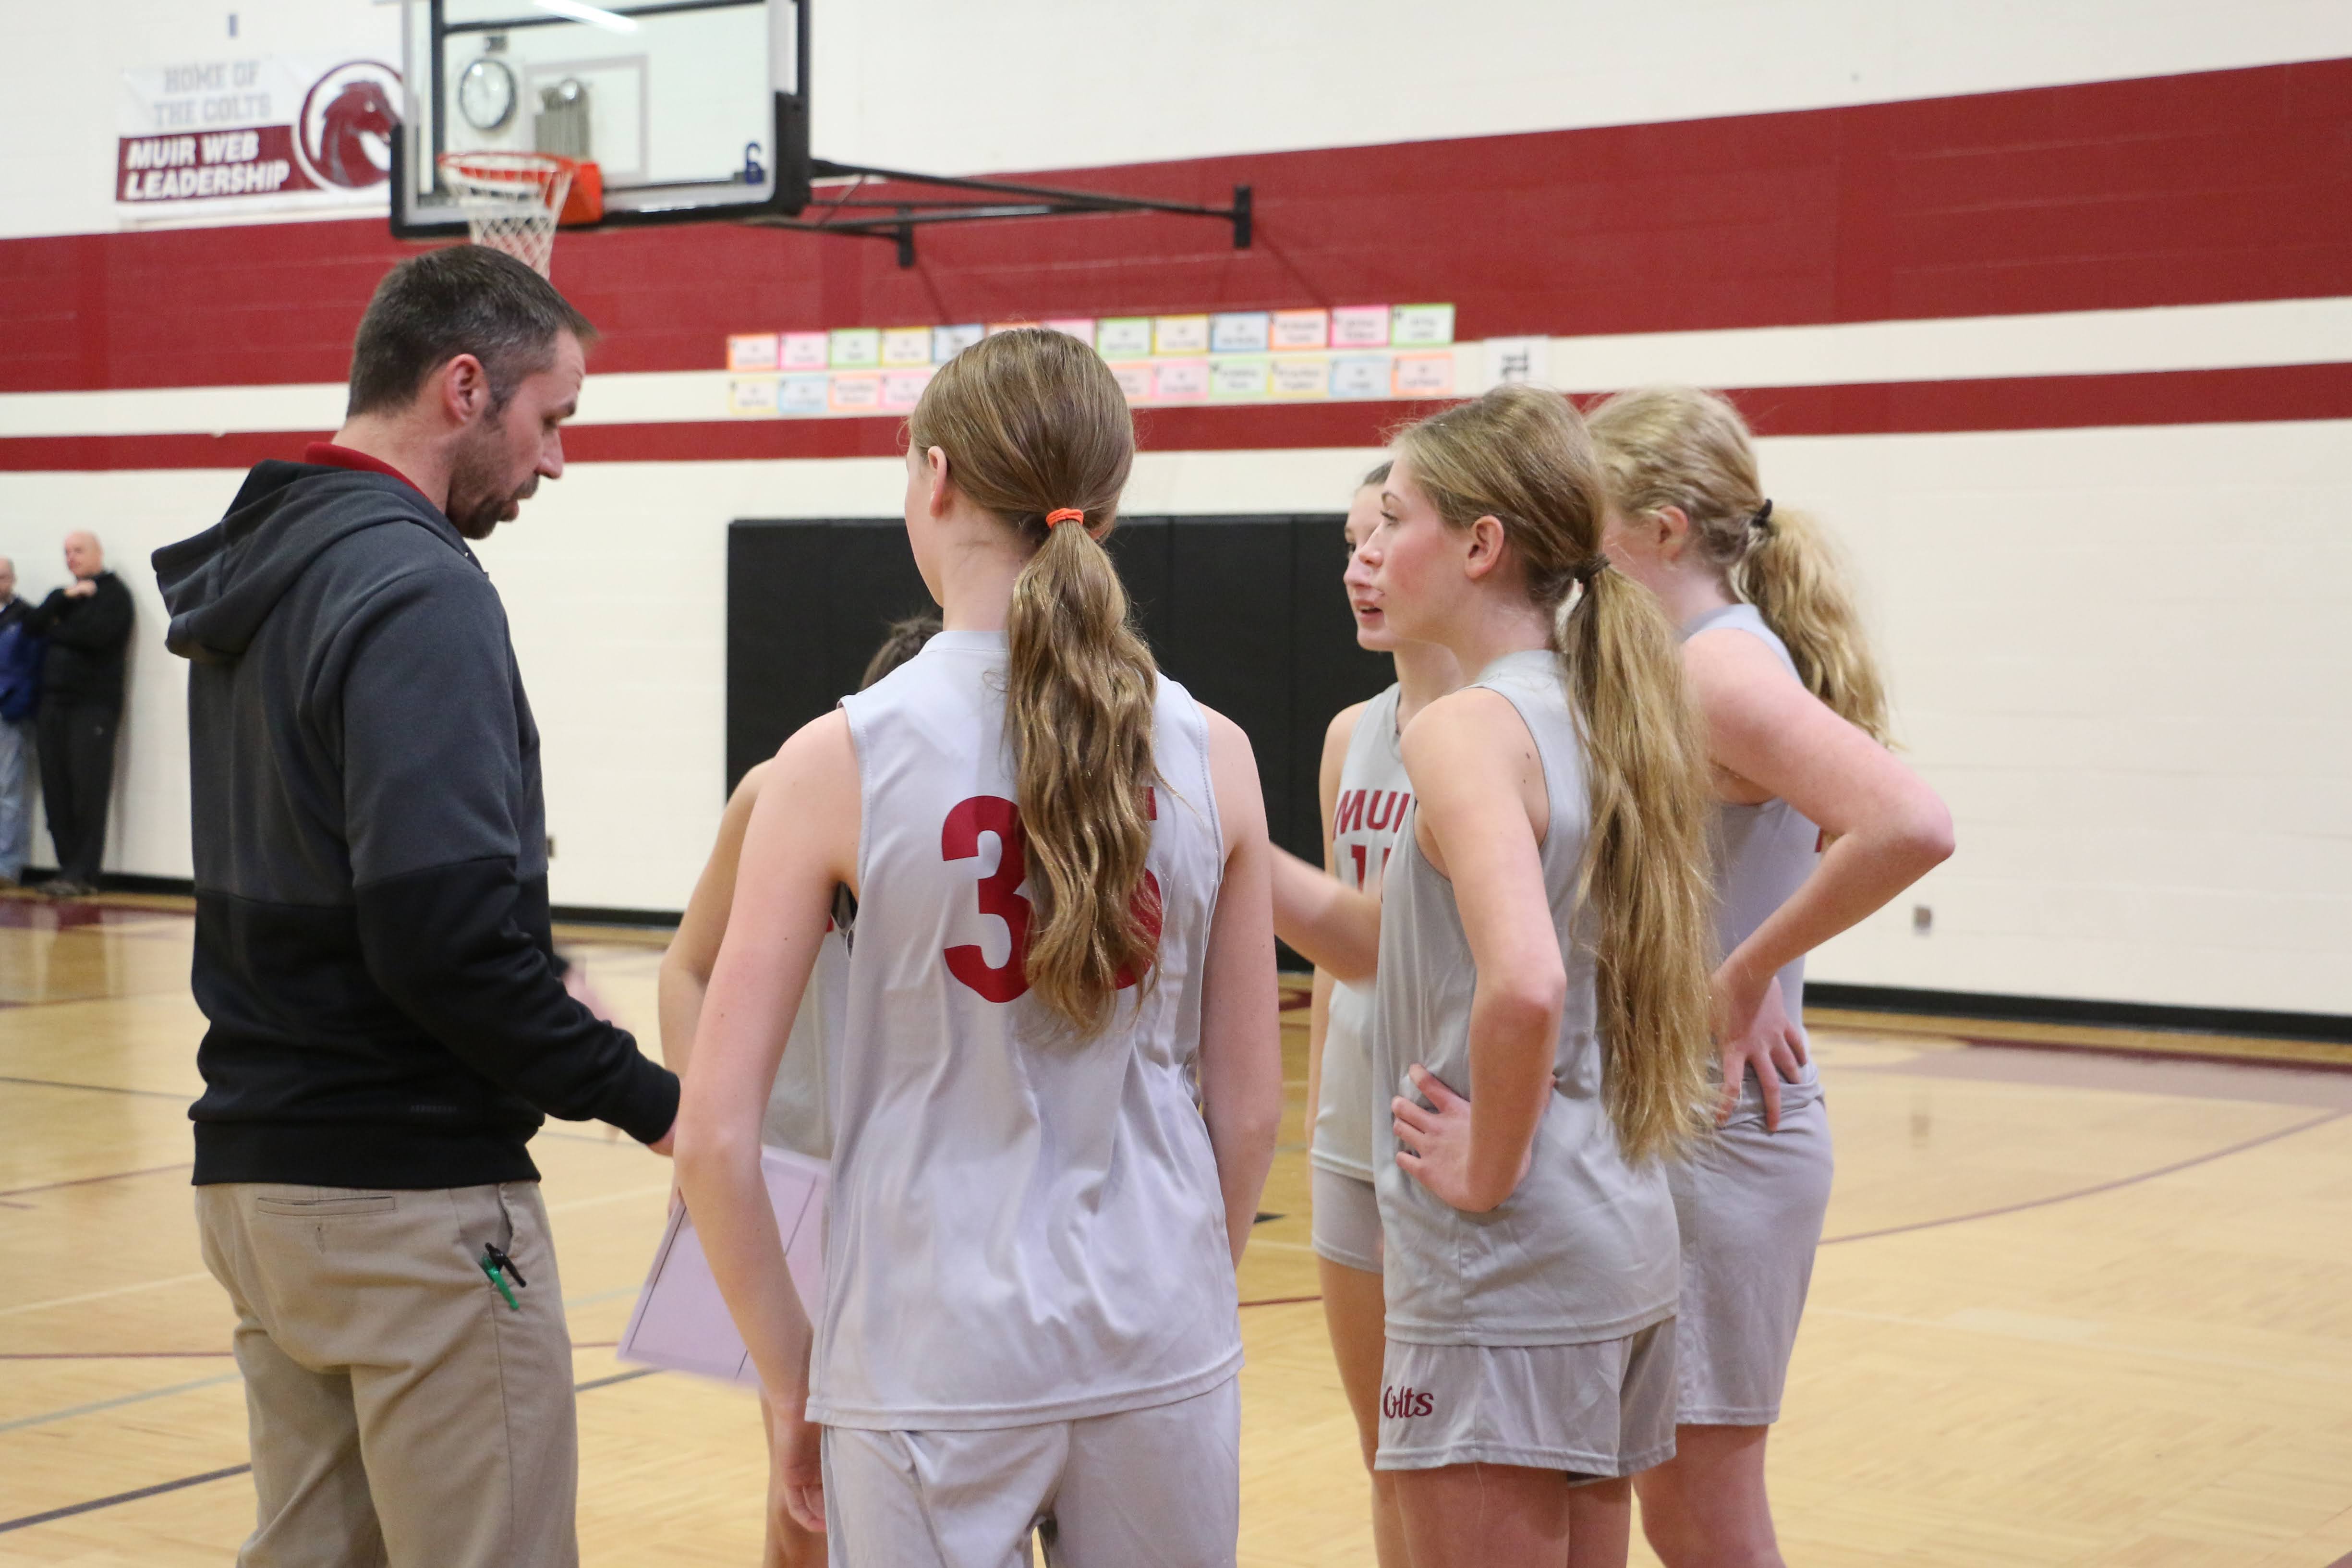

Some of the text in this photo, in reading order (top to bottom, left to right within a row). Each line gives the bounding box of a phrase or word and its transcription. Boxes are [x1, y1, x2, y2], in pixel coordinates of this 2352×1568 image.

[165, 61, 260, 93] HOME OF
[153, 93, 271, 126] THE COLTS
[126, 130, 260, 169] MUIR WEB
[125, 159, 290, 200] LEADERSHIP
[1333, 789, 1411, 841] MUI
[1350, 843, 1392, 893] 1
